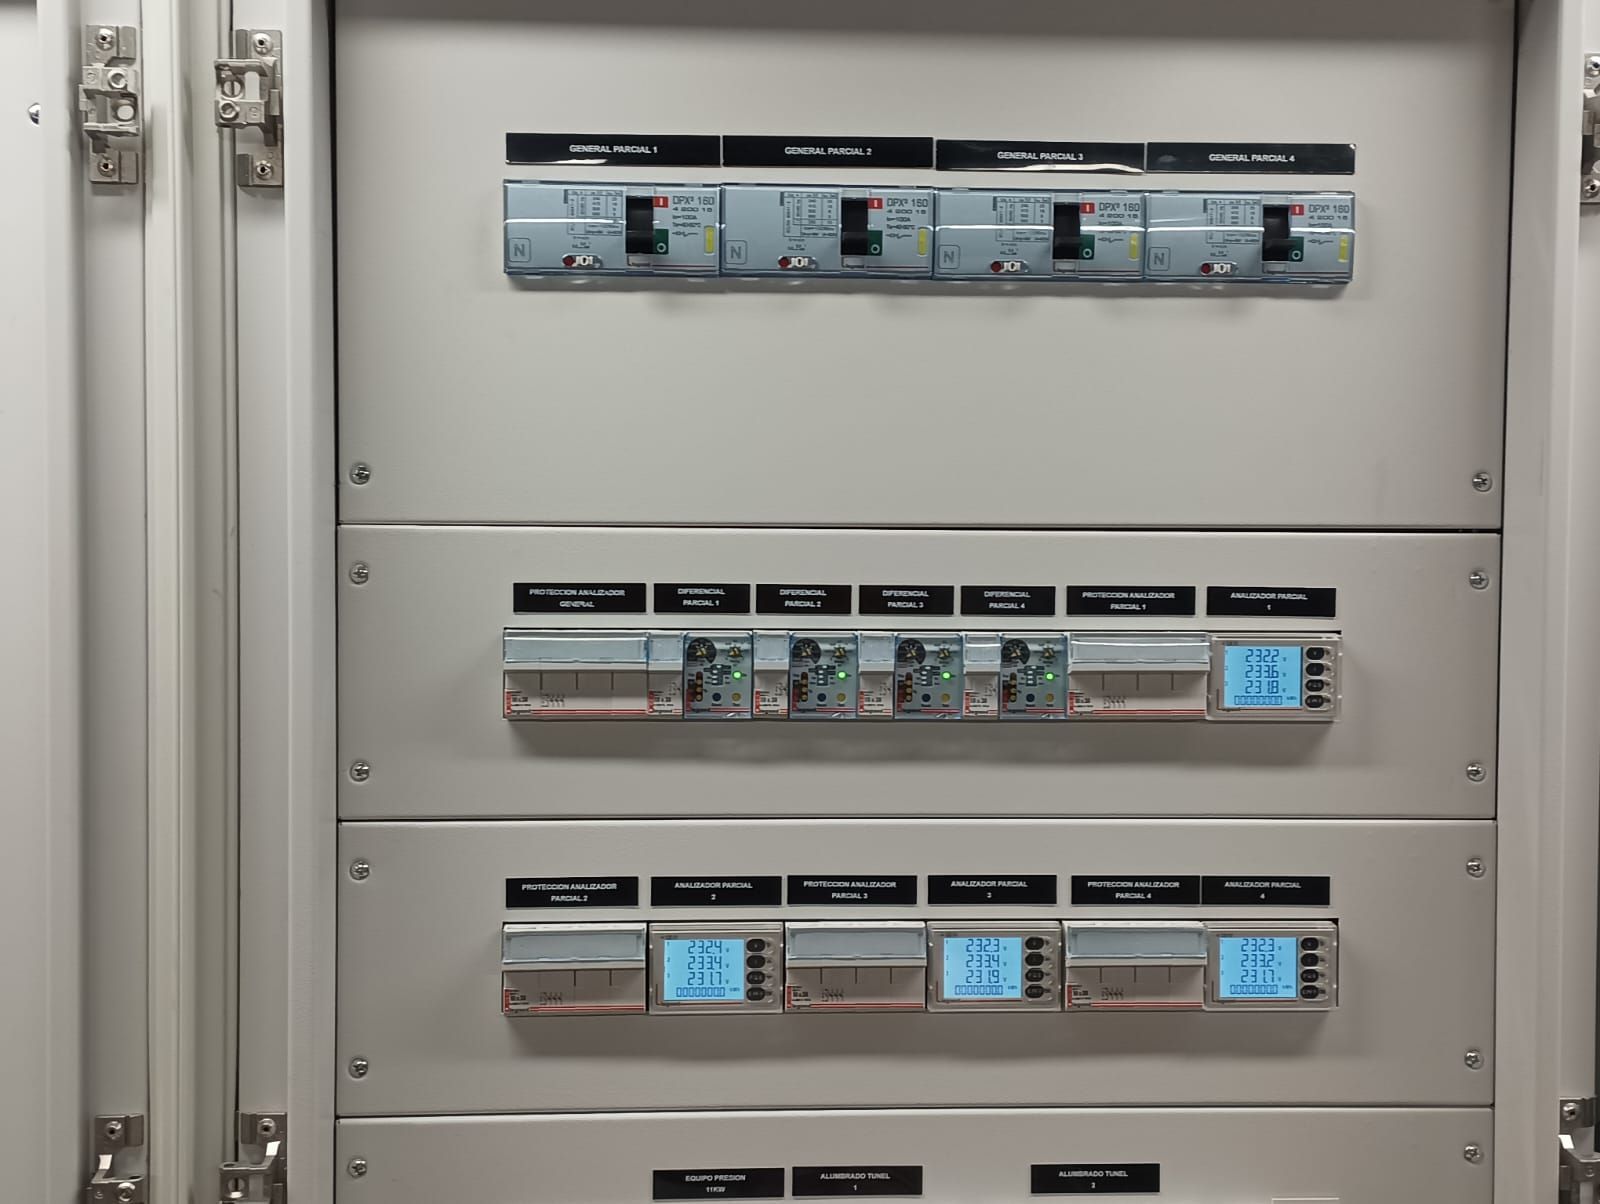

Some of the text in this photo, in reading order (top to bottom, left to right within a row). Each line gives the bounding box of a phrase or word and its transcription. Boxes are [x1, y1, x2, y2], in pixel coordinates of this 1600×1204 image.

[569, 144, 611, 154] GENERAL
[613, 144, 651, 154] PARCIAL
[784, 146, 826, 156] GENERAL
[828, 146, 865, 156] PARCIAL
[996, 151, 1038, 161] GENERAL
[1040, 151, 1078, 161] PARCIAL
[1208, 153, 1250, 163] GENERAL
[1251, 153, 1288, 163] PARCIAL
[698, 196, 715, 205] 160
[911, 198, 928, 207] 160
[1123, 203, 1140, 212] 160
[1333, 205, 1350, 213] 160
[685, 1174, 746, 1182] EQUIPO PRESION
